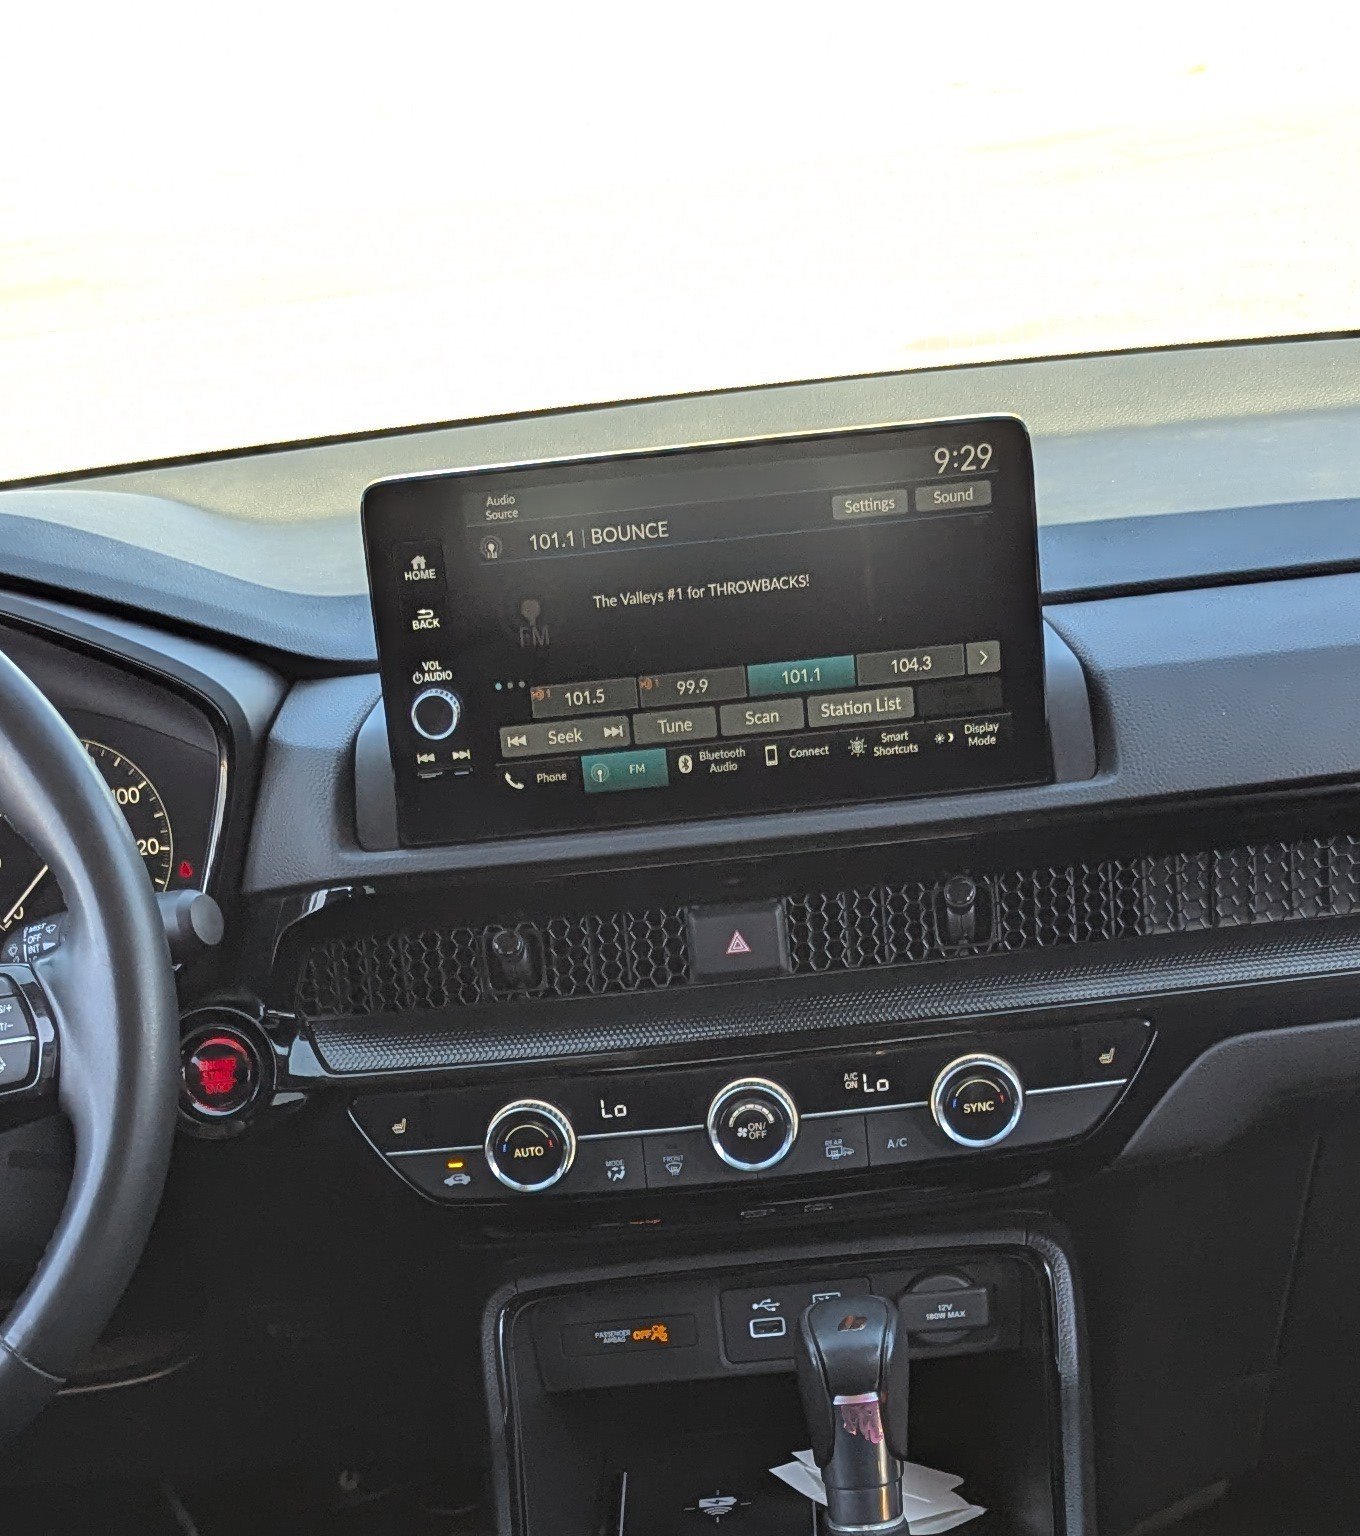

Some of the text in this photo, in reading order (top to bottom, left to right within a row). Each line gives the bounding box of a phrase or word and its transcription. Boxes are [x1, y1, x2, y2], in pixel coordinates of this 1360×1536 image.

[934, 443, 993, 474] 9:29
[486, 494, 515, 507] Audio
[845, 488, 973, 514] Settings Sound
[485, 508, 518, 520] Source
[529, 521, 669, 551] 101.1 BOUNCE
[404, 569, 436, 581] HOME
[593, 574, 810, 609] The Valleys #1 for THROWBACKS!
[412, 618, 440, 630] BACK
[422, 660, 442, 671] VOL
[890, 655, 932, 674] 104.3
[424, 671, 453, 682] AUDIO
[781, 667, 821, 686] 101.1
[676, 679, 709, 695] 99.9
[564, 689, 605, 707] 101.5
[820, 697, 902, 718] Station List
[745, 710, 779, 725] Scan
[657, 718, 693, 733] Tune
[964, 722, 999, 736] Display
[548, 729, 583, 745] Seek
[881, 731, 909, 743] Smart
[968, 734, 996, 747] Mode
[699, 748, 746, 762] Bluetooth
[789, 746, 830, 759] Connect
[873, 743, 919, 757] Shortcuts
[629, 763, 646, 775] FM
[709, 761, 738, 774] Audio
[536, 771, 567, 784] Phone
[136, 838, 159, 856] 20
[843, 1071, 859, 1081] A/C
[844, 1080, 858, 1089] ON
[963, 1101, 995, 1114] SYNC
[749, 1130, 767, 1140] OFF
[887, 1138, 907, 1149] A/C
[514, 1146, 544, 1159] AUTO
[947, 1310, 966, 1318] MAX
